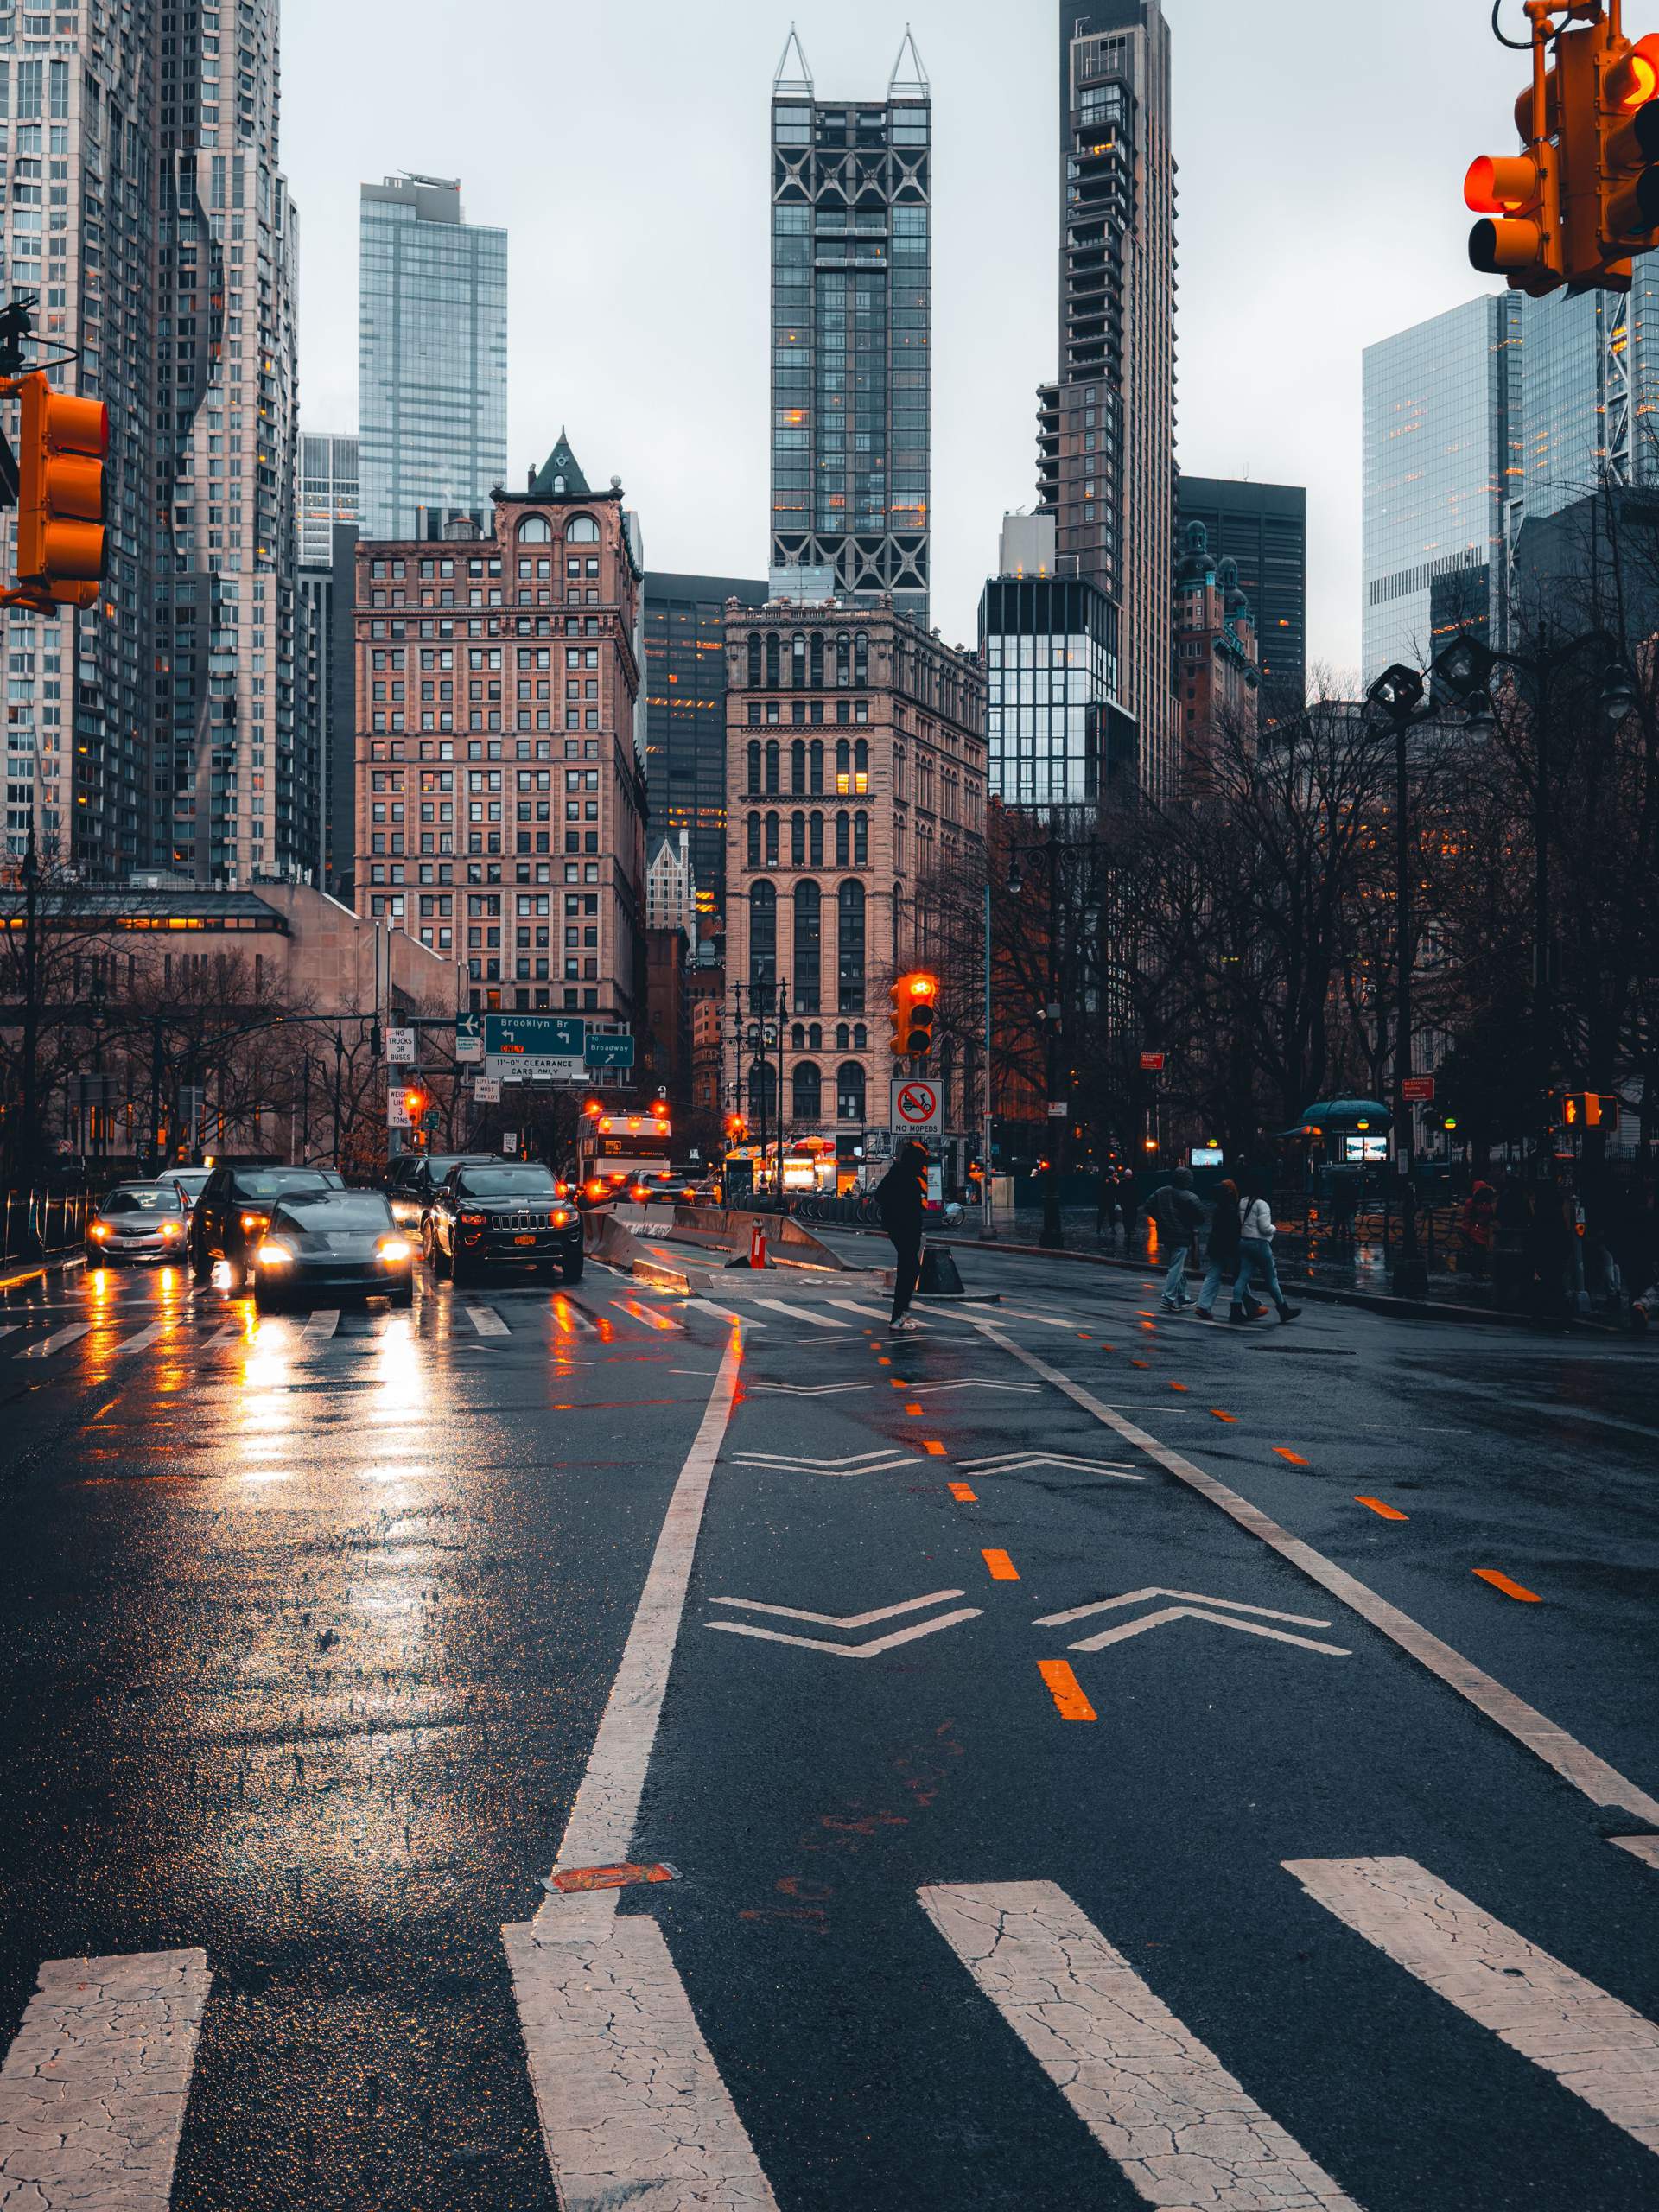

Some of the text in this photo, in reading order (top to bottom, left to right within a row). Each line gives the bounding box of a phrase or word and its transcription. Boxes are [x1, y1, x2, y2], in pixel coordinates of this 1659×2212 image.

[500, 1018, 569, 1029] Brooklyn Br
[590, 1044, 629, 1052] Broadway
[397, 1107, 403, 1116] 3
